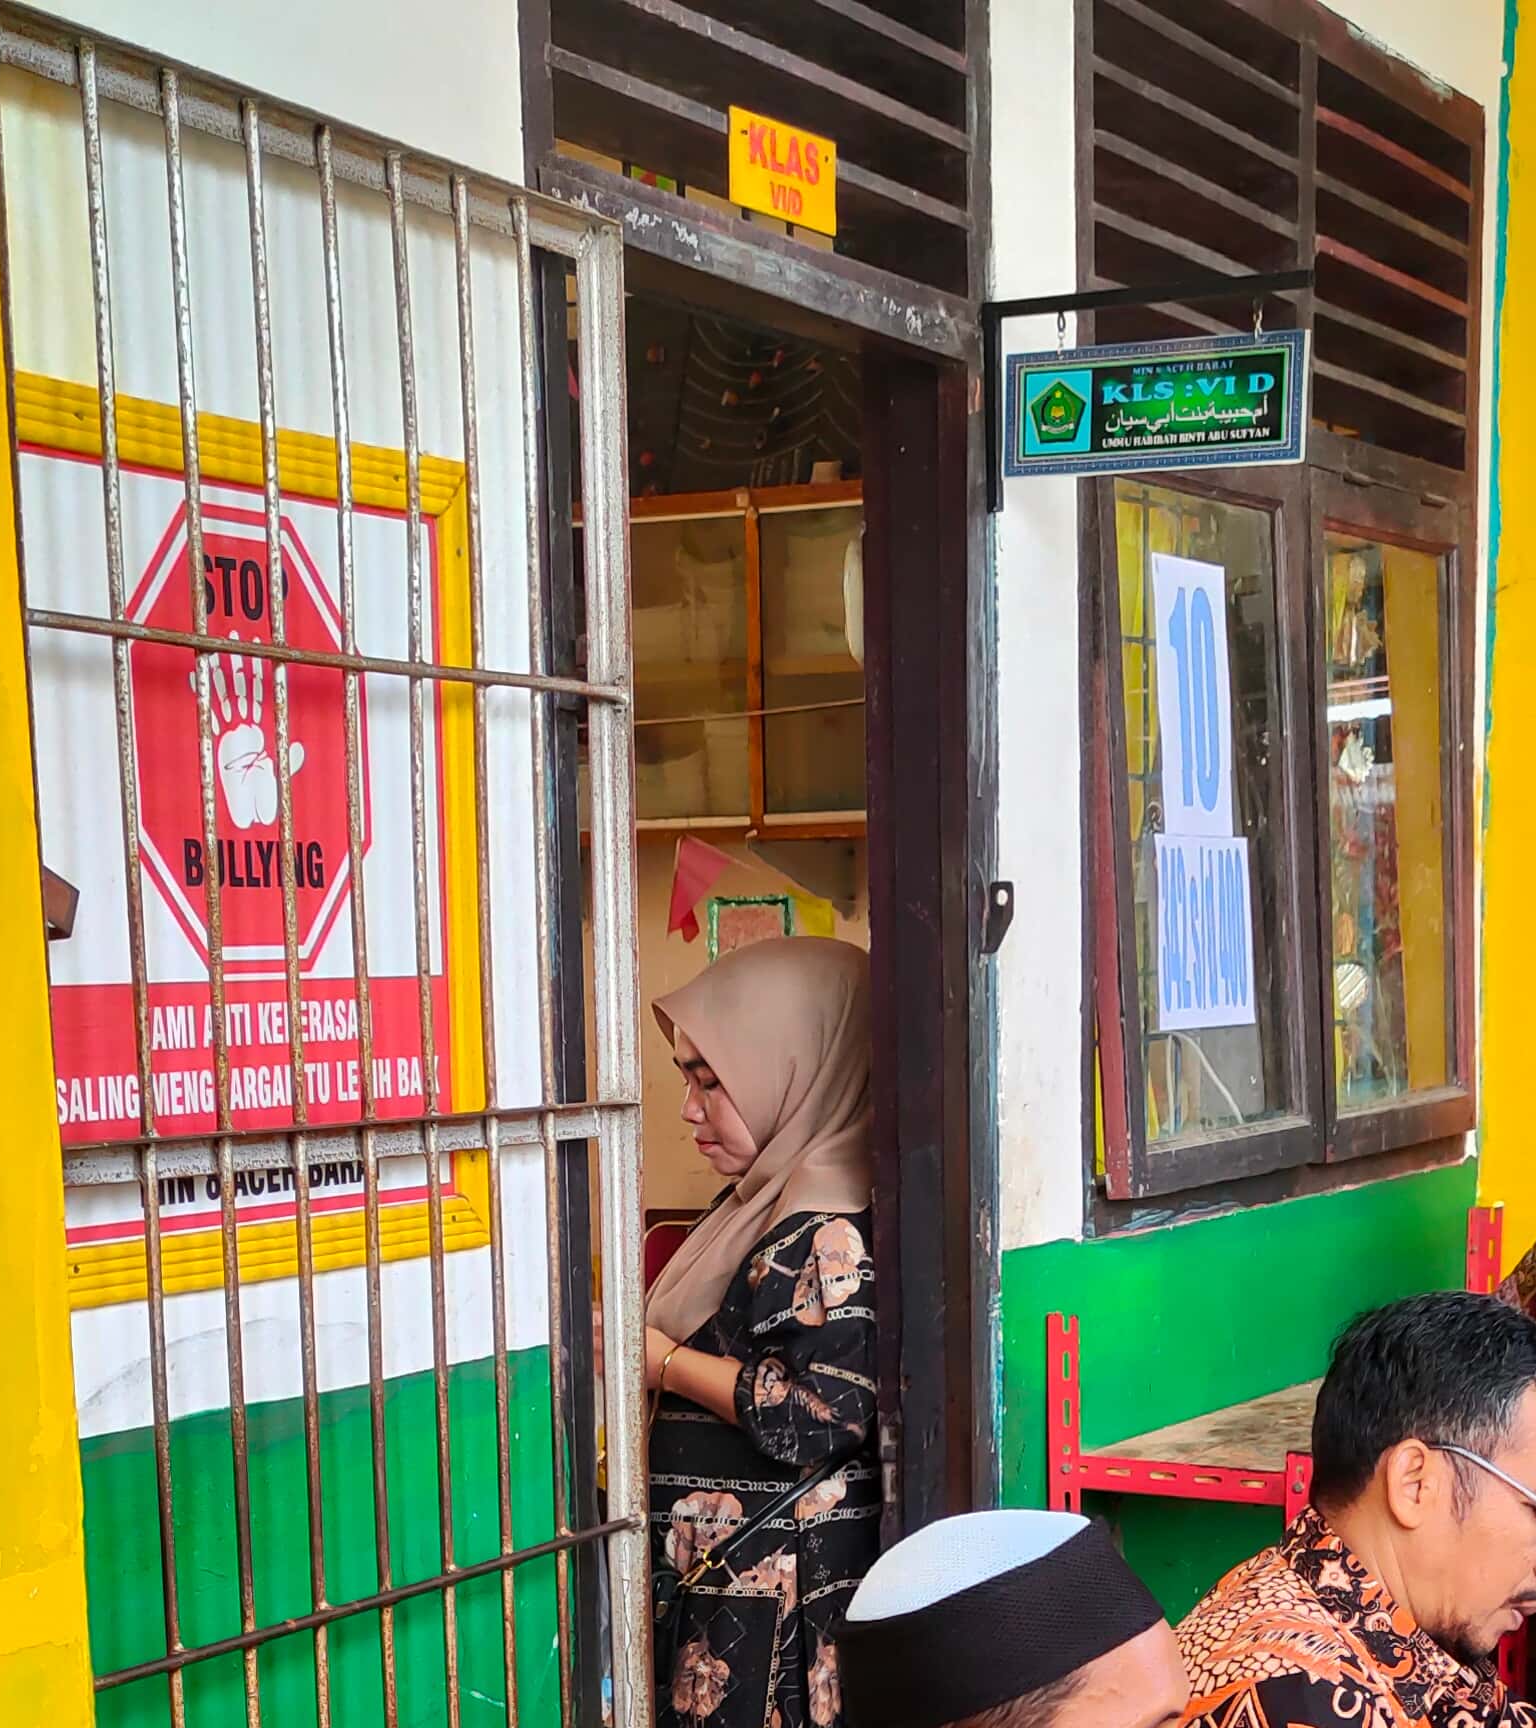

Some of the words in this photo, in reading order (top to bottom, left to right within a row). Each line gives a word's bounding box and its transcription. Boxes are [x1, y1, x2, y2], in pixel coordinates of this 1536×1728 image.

[749, 120, 820, 186] KLAS
[1102, 381, 1175, 405] KLS
[1248, 372, 1275, 394] D
[1207, 429, 1229, 442] ABU
[202, 554, 289, 621] STO
[1168, 587, 1220, 812] 10
[1218, 847, 1248, 1008] 400
[148, 1005, 197, 1051] AMI
[257, 998, 373, 1046] KEERASA
[56, 1074, 141, 1125] SALING
[151, 1064, 292, 1117] MENGARGAI
[303, 1061, 331, 1104] TU
[336, 1058, 392, 1102] LEIH
[396, 1055, 441, 1097] BAK
[140, 1176, 195, 1208] IN
[308, 1160, 380, 1189] BARA
